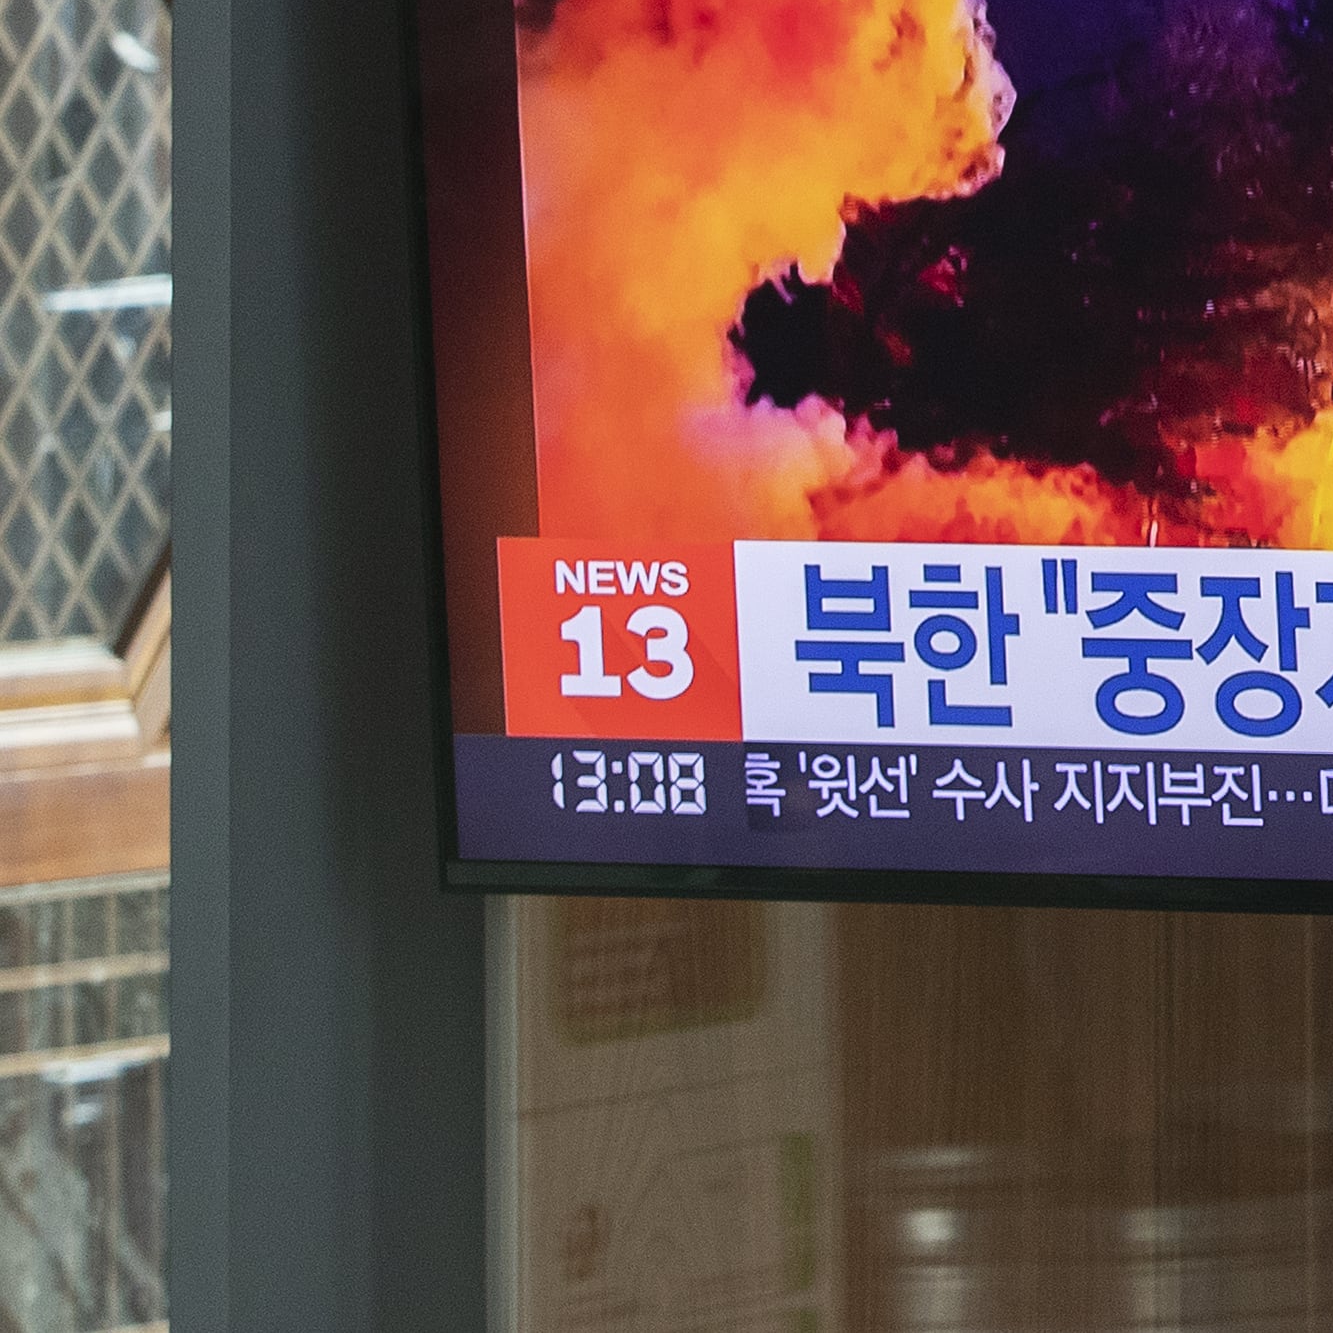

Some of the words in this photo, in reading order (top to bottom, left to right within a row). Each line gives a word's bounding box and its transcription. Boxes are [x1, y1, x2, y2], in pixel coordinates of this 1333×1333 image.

[555, 560, 690, 596] NEWS
[560, 605, 694, 700] 13
[795, 564, 1020, 728] 북한
[551, 750, 708, 816] 13:08
[798, 750, 918, 819] '윗선'
[932, 758, 1040, 823] 수사
